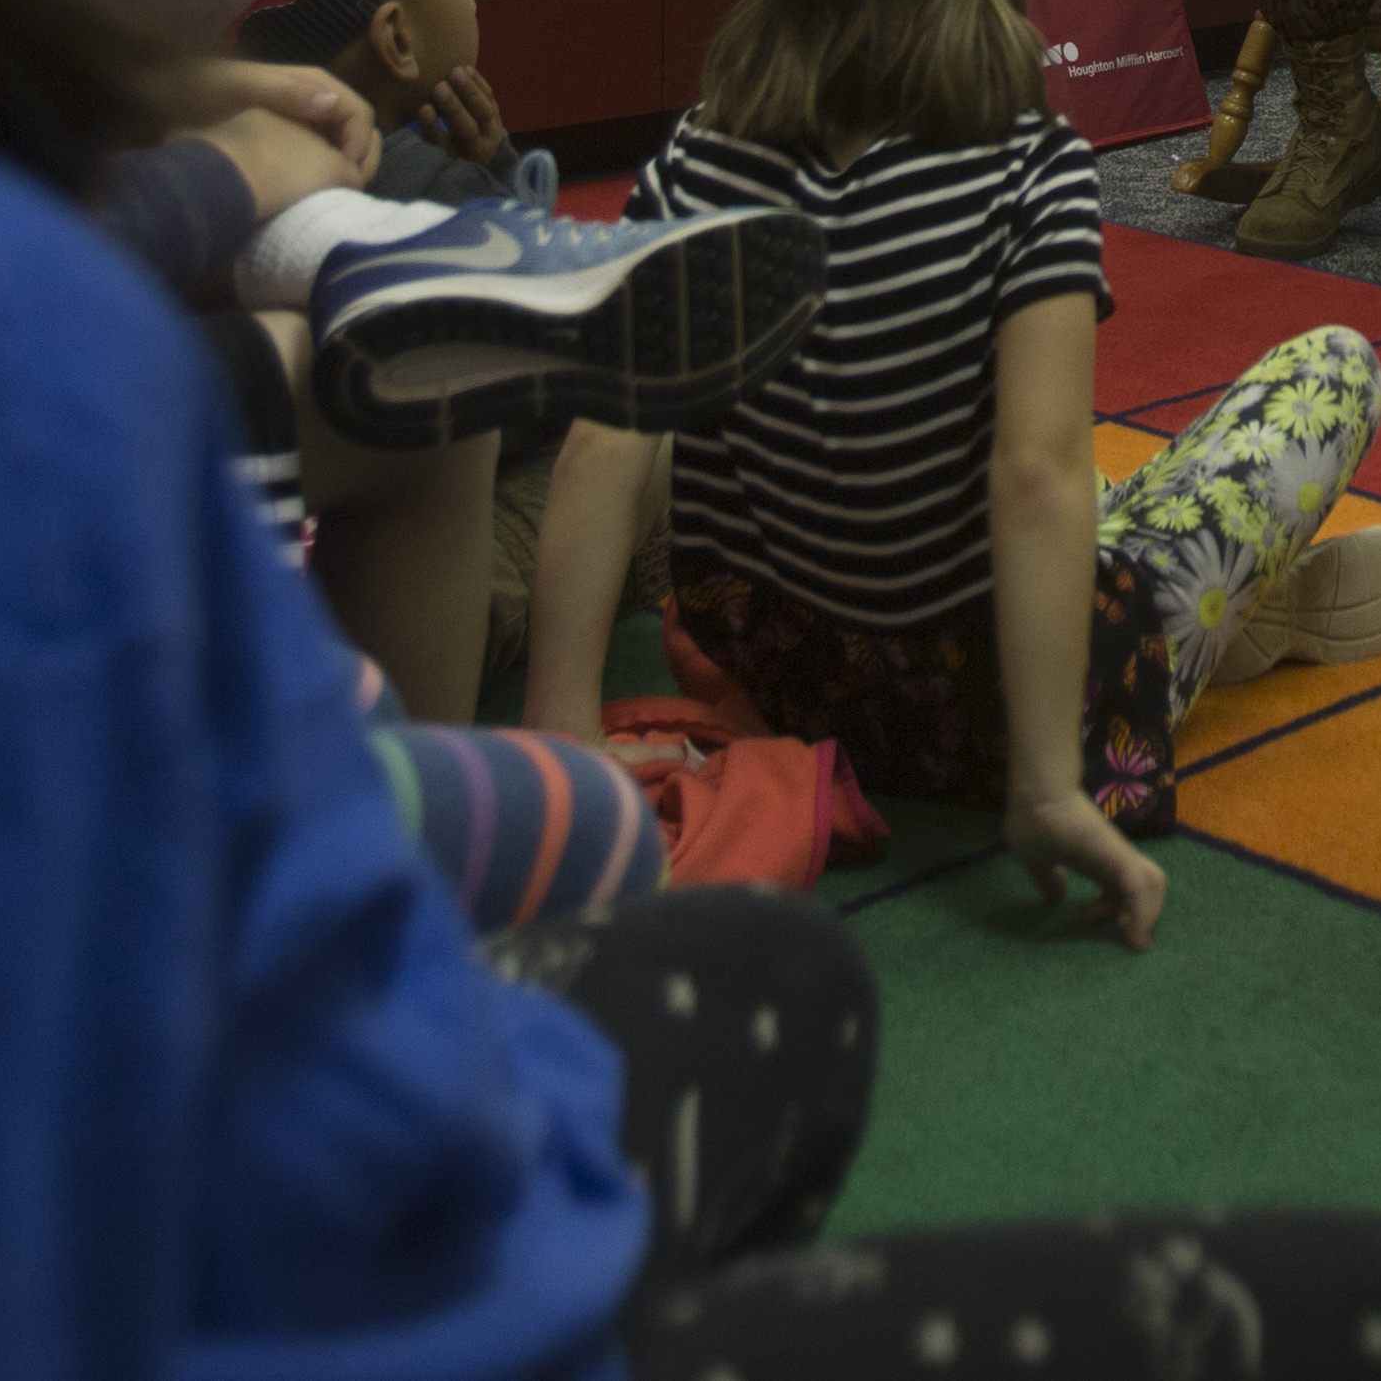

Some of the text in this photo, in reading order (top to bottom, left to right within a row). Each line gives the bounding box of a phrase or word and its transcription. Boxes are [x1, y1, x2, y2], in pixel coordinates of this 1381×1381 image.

[1068, 45, 1185, 78] Houghton Mifflin Harcourt
